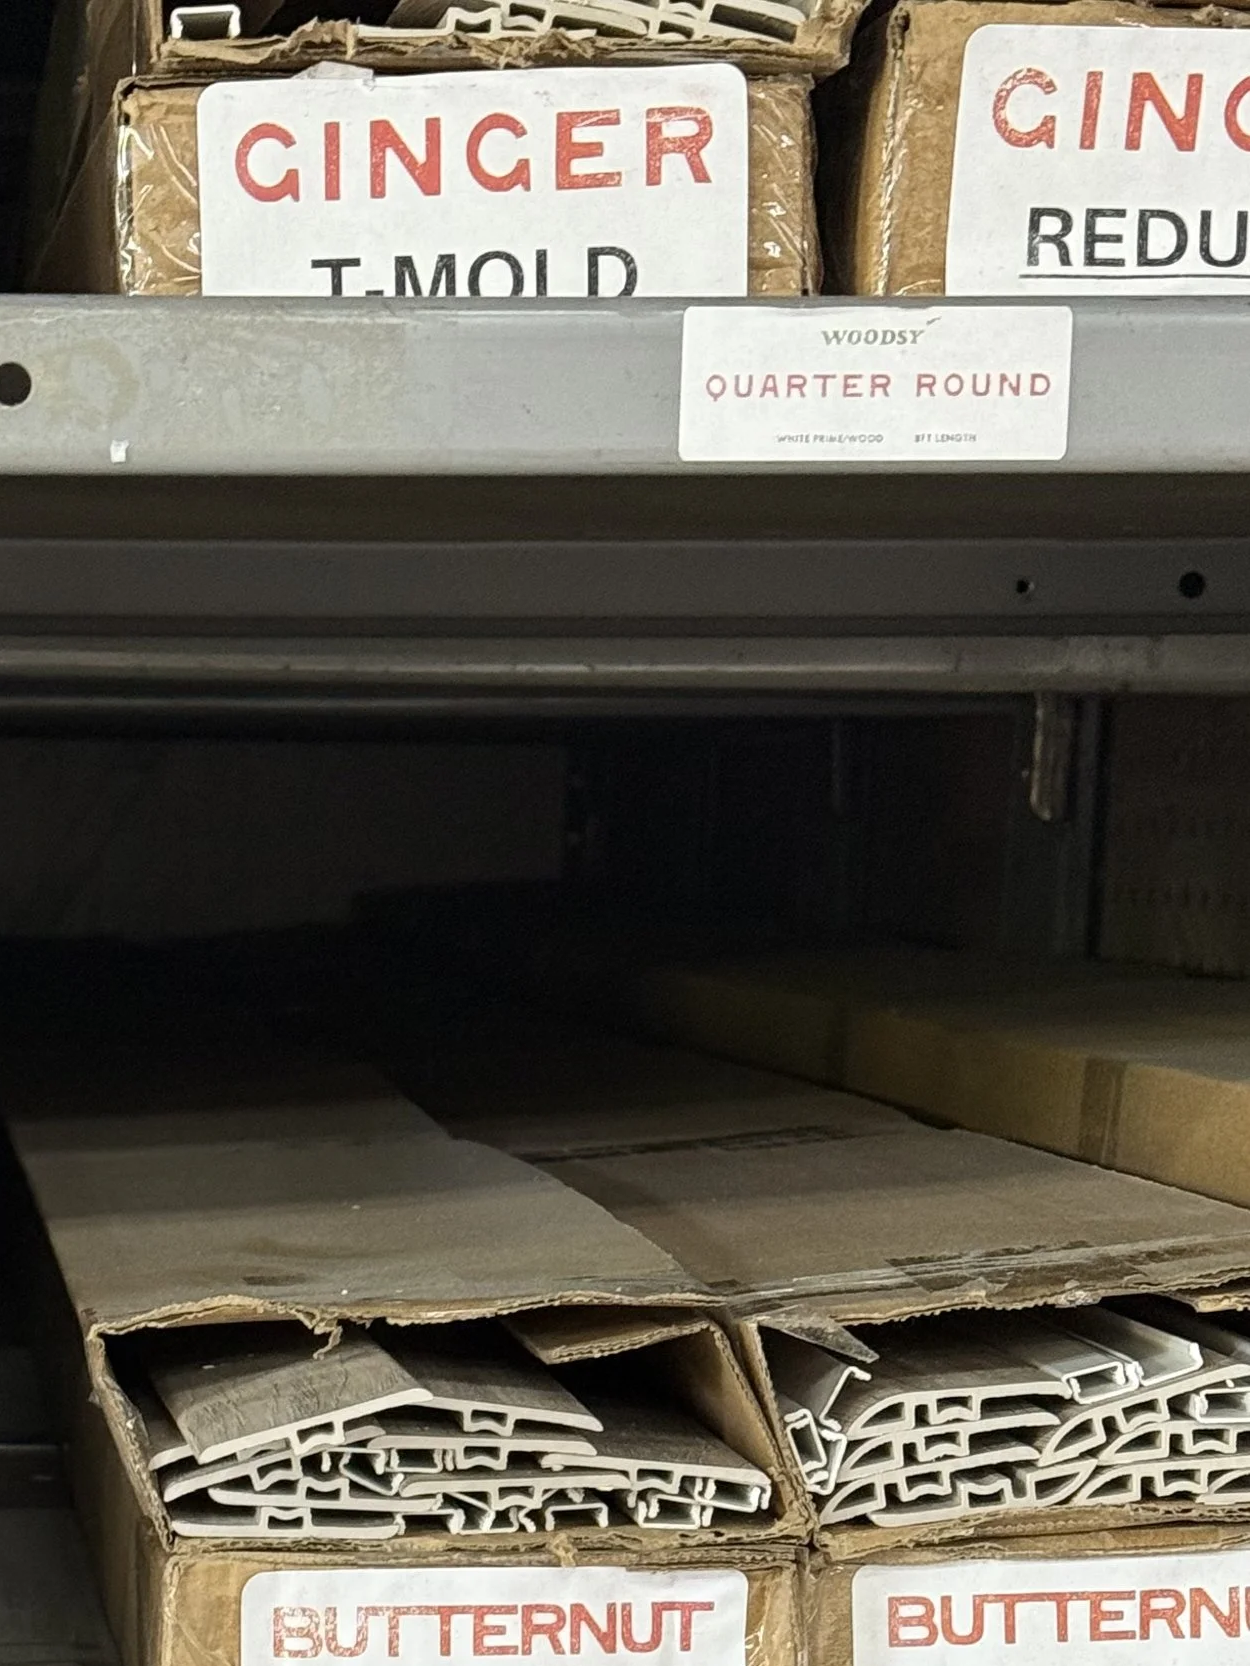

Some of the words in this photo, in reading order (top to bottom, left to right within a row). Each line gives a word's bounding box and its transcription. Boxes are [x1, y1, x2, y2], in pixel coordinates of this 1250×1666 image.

[235, 105, 713, 203] GINGER
[1026, 206, 1249, 268] REDU
[311, 246, 638, 297] T-MOLD
[821, 328, 925, 346] WOODSY
[705, 373, 892, 402] QUARTER
[915, 372, 1052, 399] ROUND
[271, 1600, 716, 1659] BUTTERNUT
[888, 1586, 1250, 1648] BUTTERN
